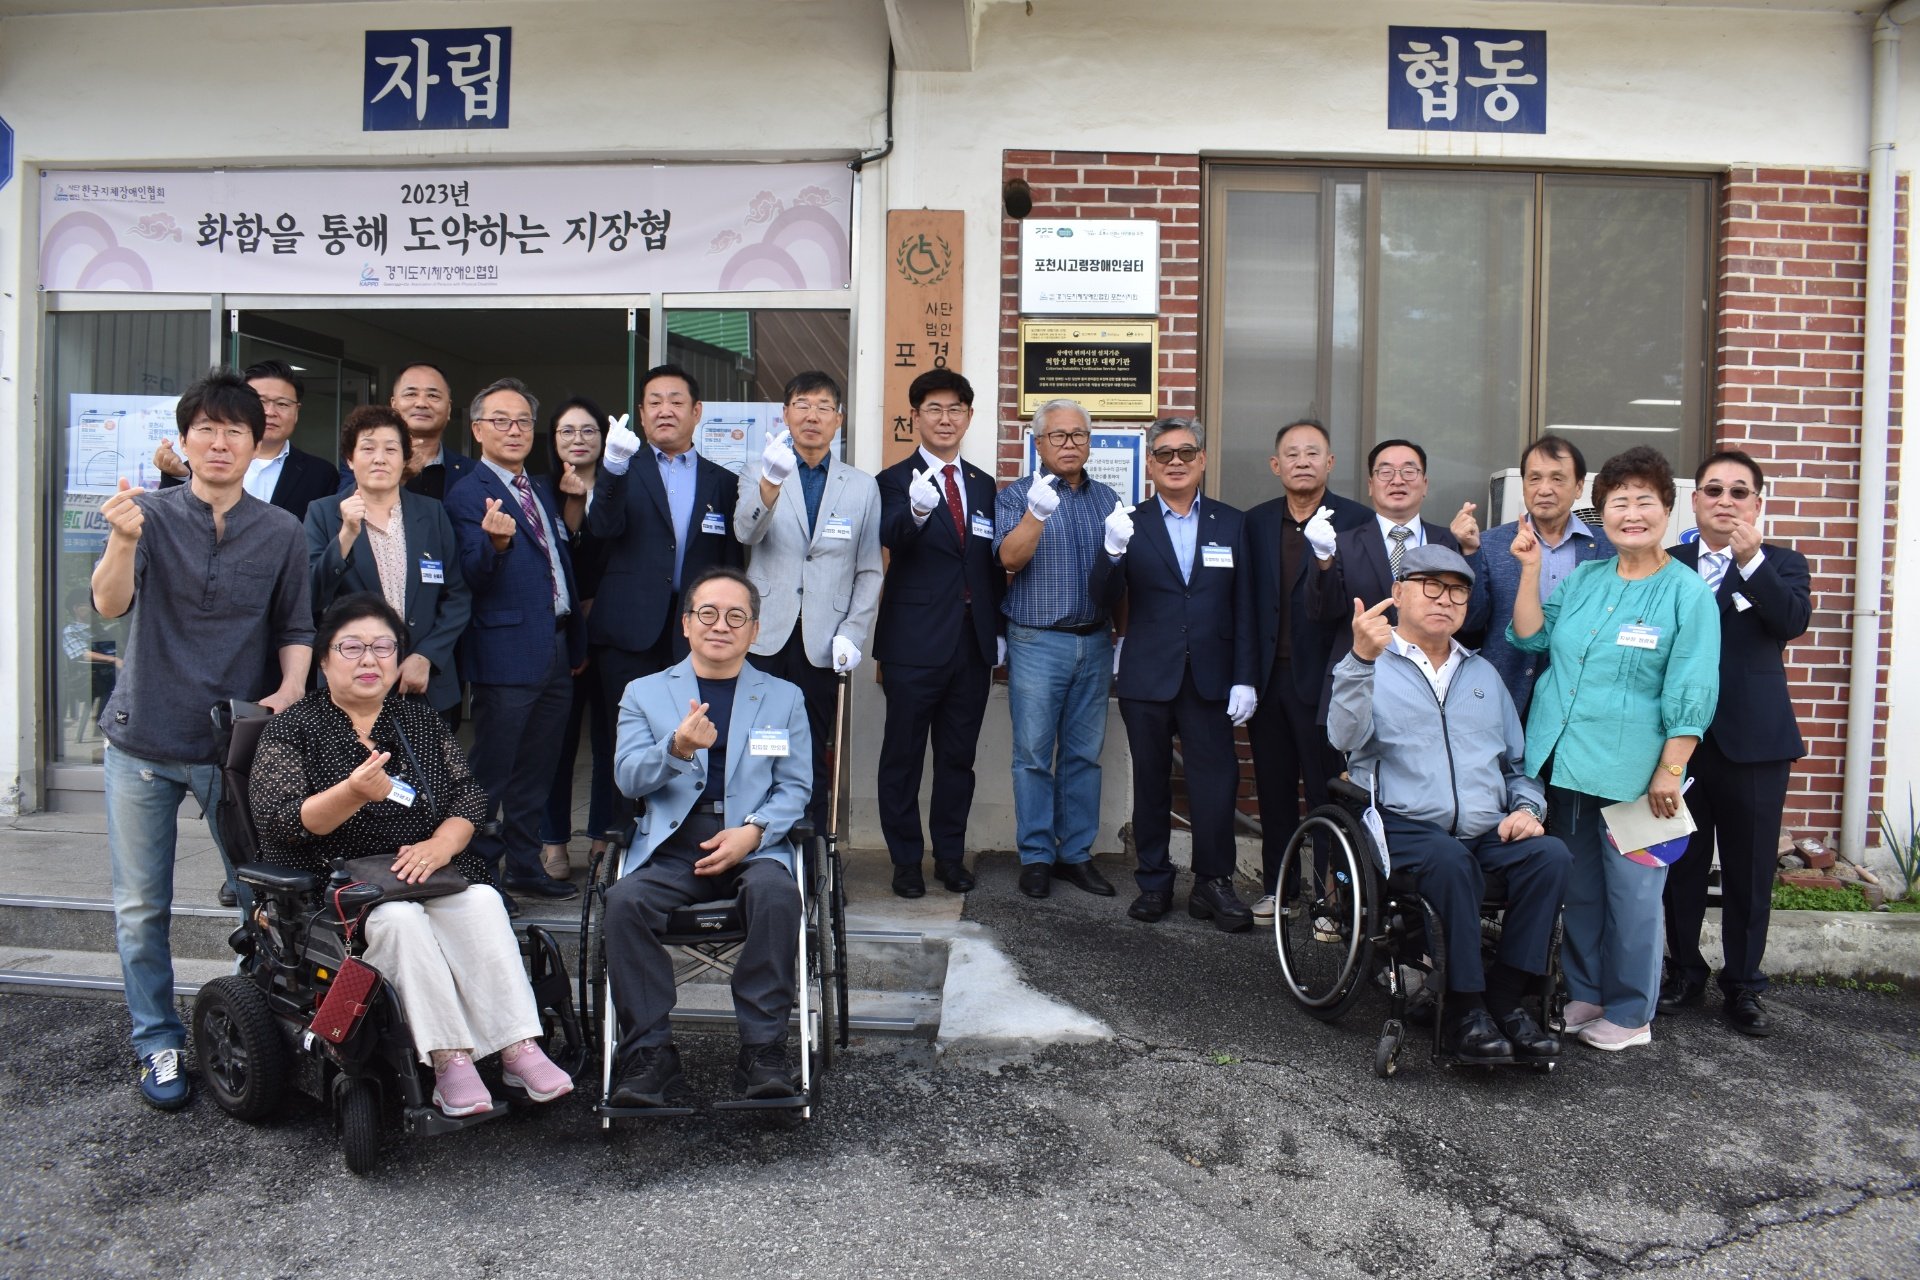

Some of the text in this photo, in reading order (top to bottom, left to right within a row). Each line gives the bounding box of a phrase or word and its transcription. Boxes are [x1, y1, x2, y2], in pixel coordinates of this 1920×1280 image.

[370, 34, 501, 121] 자립
[1398, 36, 1538, 122] 협동
[82, 184, 165, 200] 한국지체장애인협회
[400, 180, 469, 207] 2023년
[197, 208, 671, 256] 화합을 통해 도약하는 지장협
[385, 265, 499, 280] 경기도지체장애인협회
[1034, 258, 1144, 272] 포천시고령장애인쉼터
[925, 302, 953, 316] 사단
[925, 322, 952, 337] 법인
[1101, 357, 1131, 366] 대행기관
